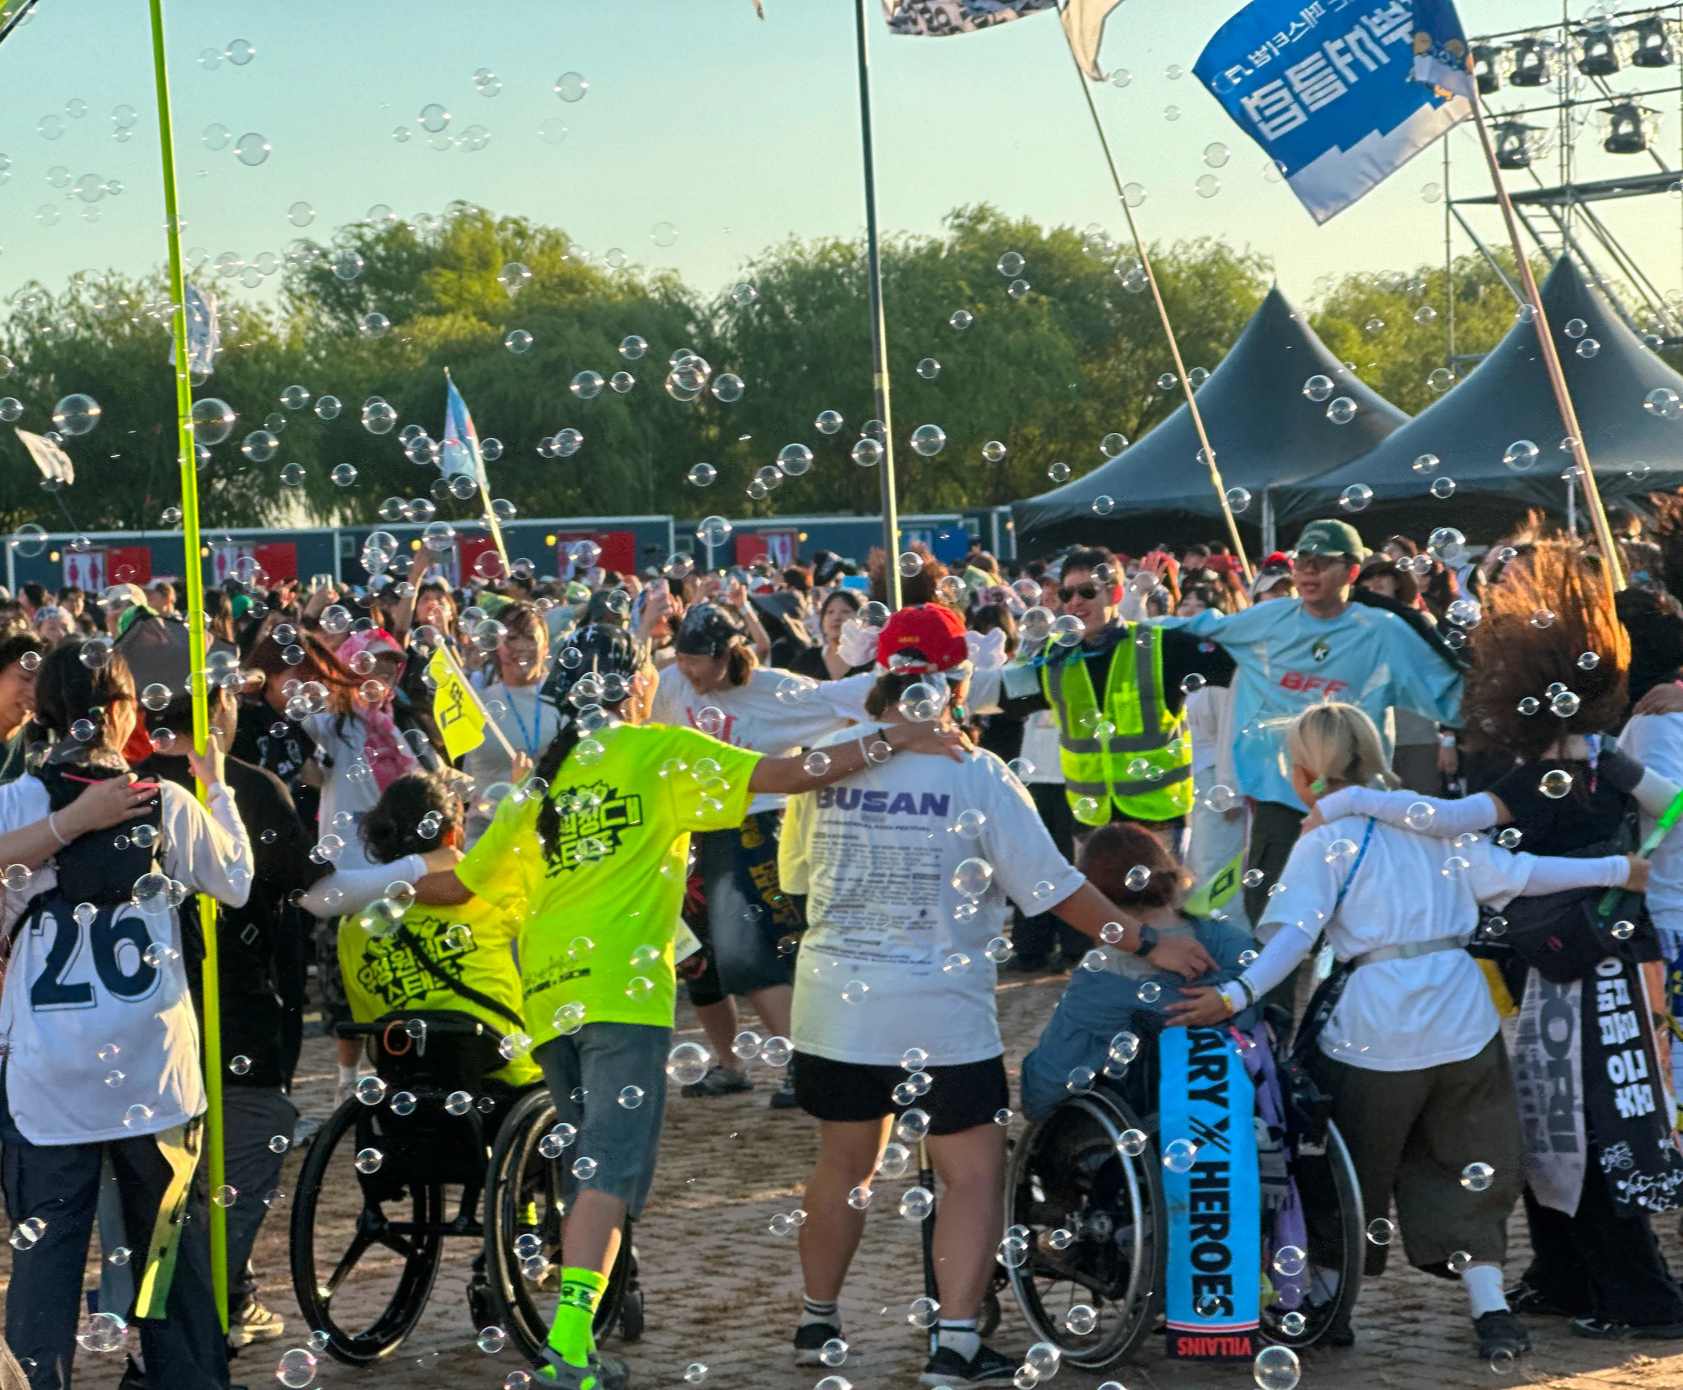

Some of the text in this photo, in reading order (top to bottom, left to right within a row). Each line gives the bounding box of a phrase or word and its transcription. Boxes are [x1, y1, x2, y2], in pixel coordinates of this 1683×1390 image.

[1280, 669, 1349, 697] BFF
[816, 787, 951, 817] BUSAN
[30, 898, 163, 1012] 26
[1186, 1025, 1231, 1109] ARY
[1537, 980, 1579, 1153] ORI
[1188, 1160, 1234, 1318] HEROES
[1176, 1336, 1252, 1357] VILLAINS
